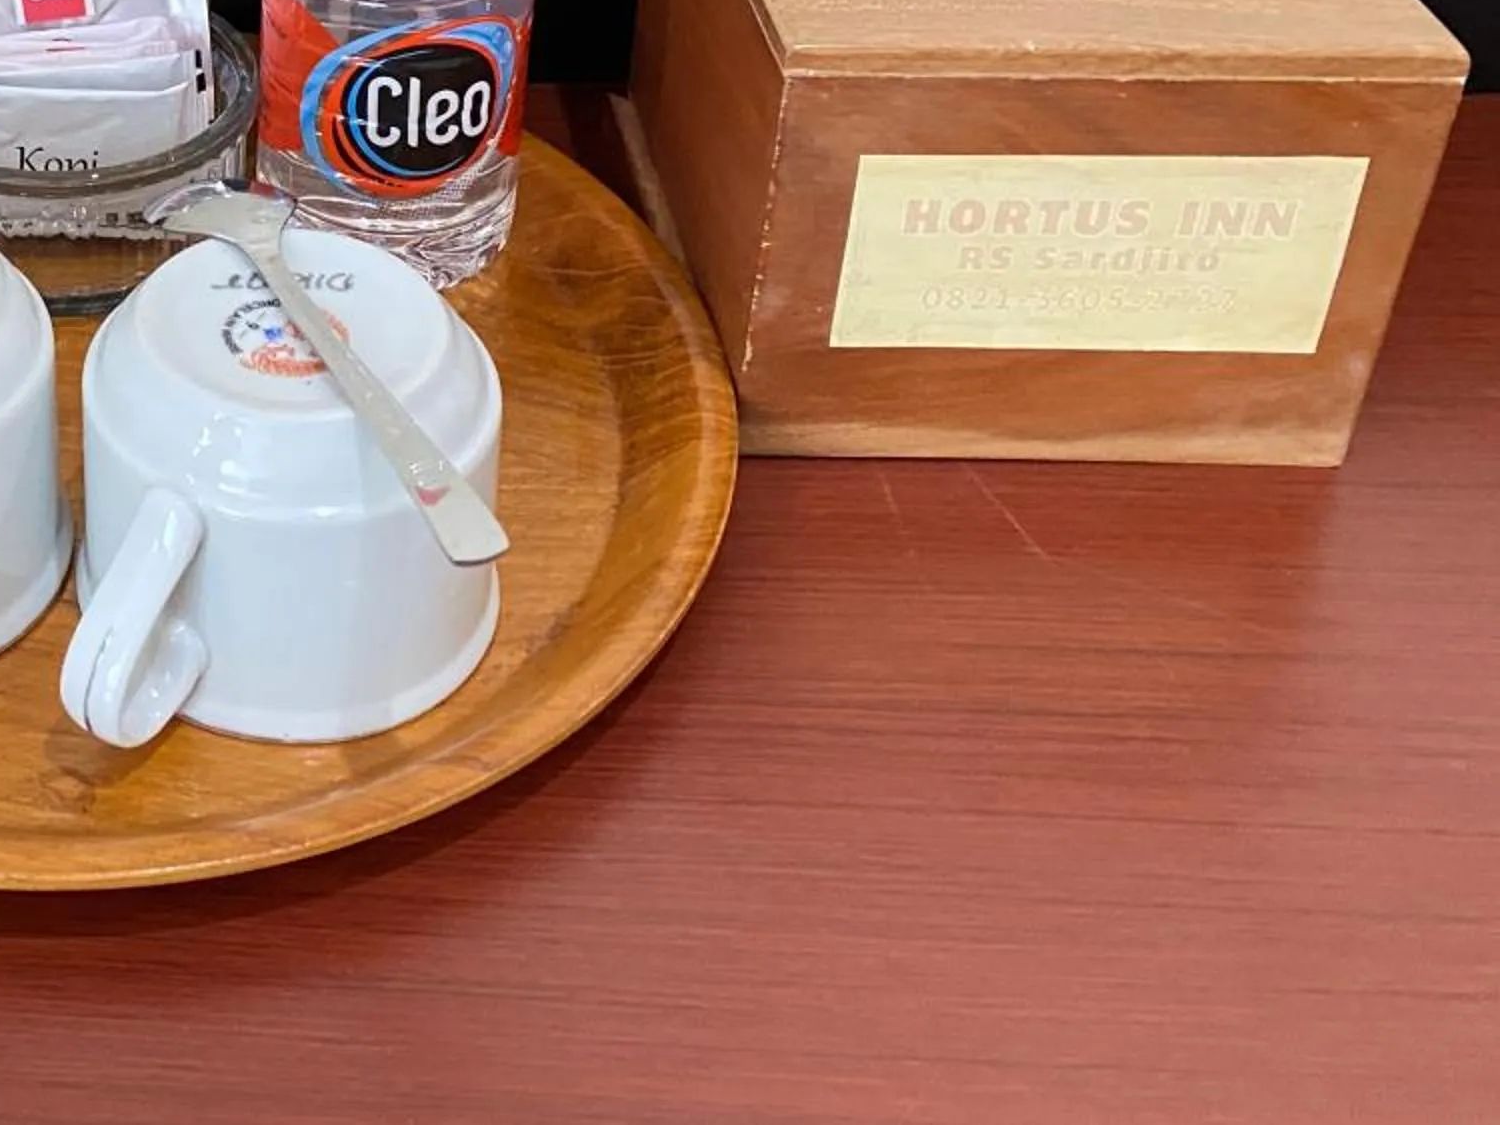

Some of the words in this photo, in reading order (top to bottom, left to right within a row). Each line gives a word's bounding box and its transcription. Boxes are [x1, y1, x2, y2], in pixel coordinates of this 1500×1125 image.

[366, 76, 491, 148] Cleo
[901, 199, 1152, 236] HORTUS
[1177, 200, 1298, 237] INN
[956, 246, 1014, 270] RS
